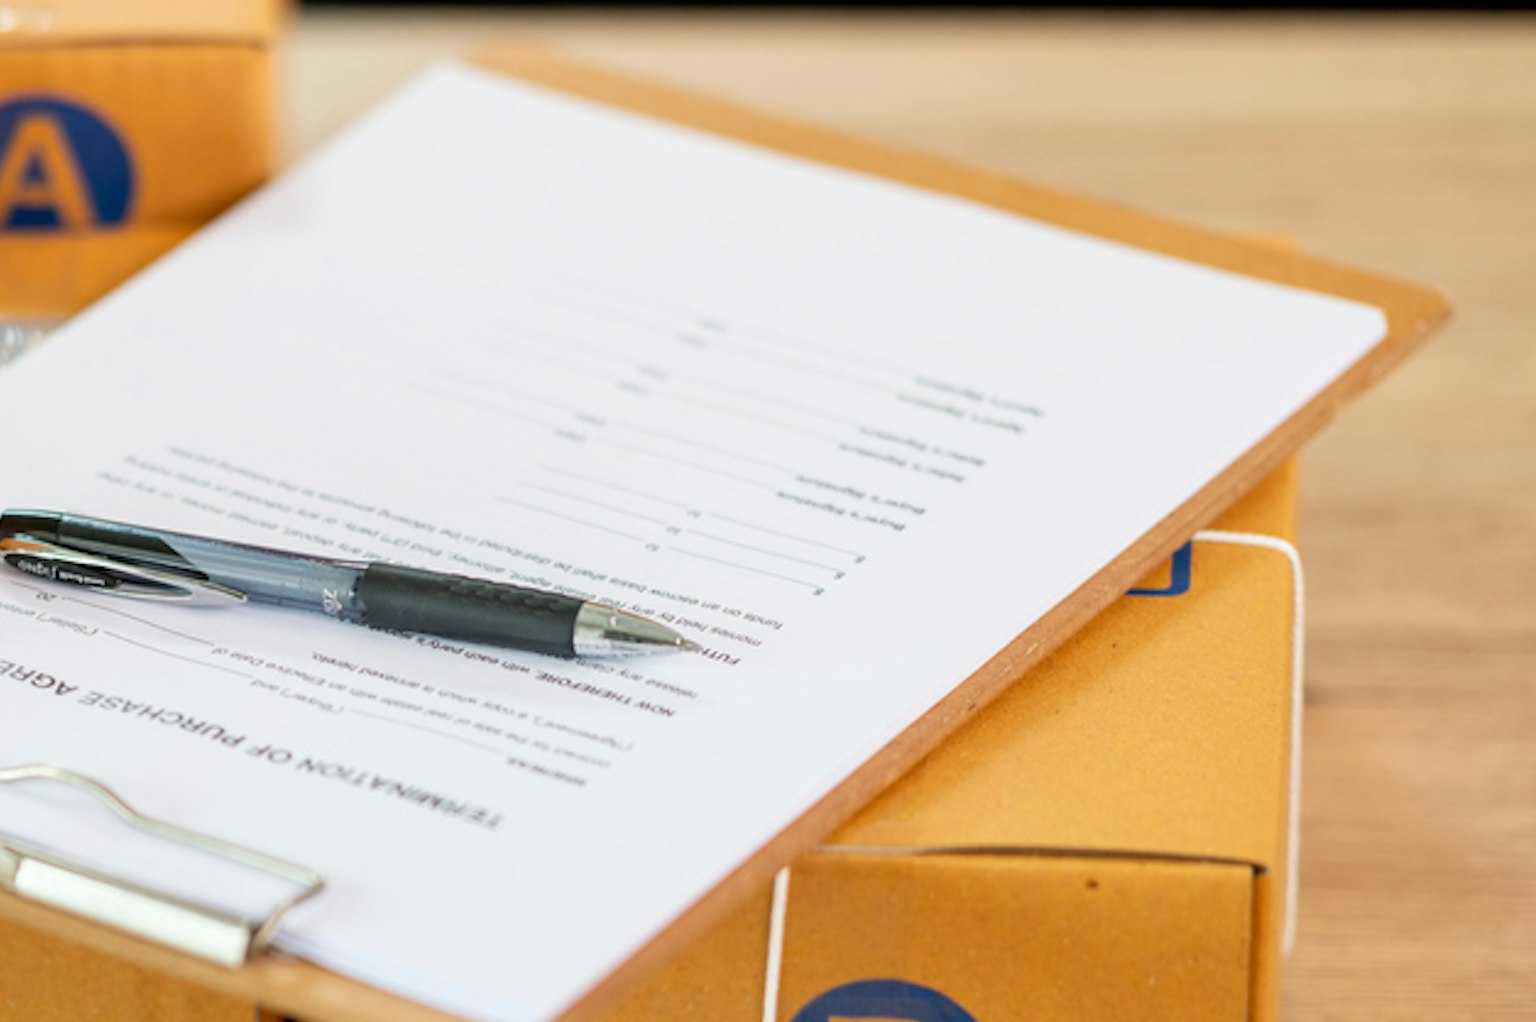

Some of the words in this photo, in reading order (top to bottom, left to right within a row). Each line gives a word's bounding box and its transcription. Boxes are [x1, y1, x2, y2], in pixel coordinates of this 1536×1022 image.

[78, 691, 246, 748] PURCHASE
[248, 745, 293, 763] OF
[296, 757, 500, 828] TERMINATION
